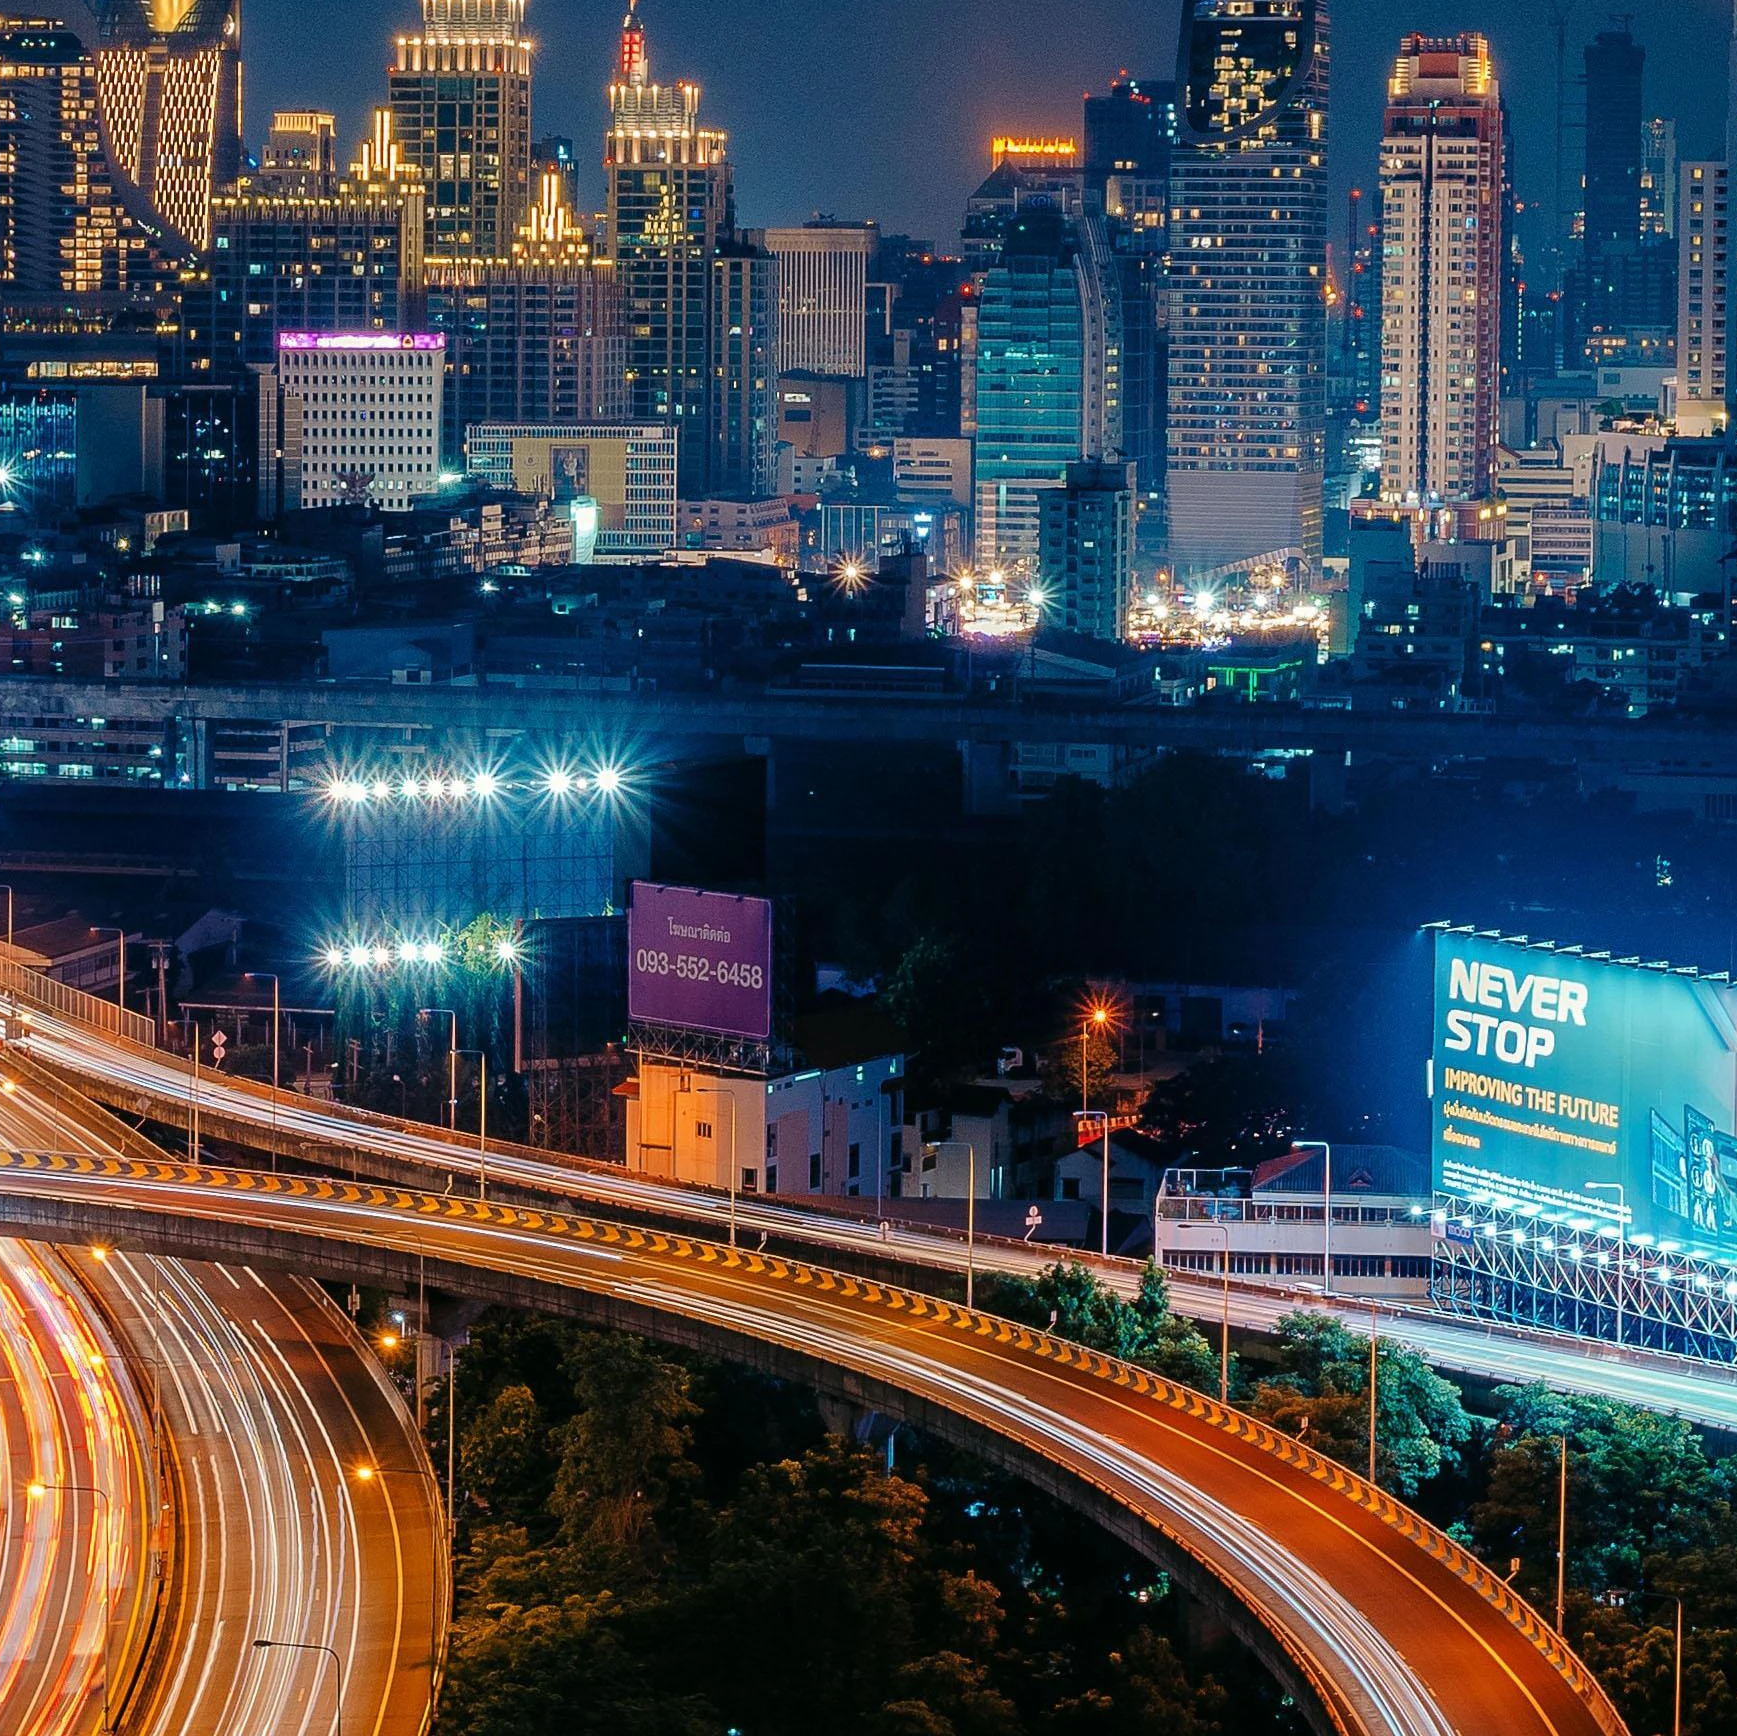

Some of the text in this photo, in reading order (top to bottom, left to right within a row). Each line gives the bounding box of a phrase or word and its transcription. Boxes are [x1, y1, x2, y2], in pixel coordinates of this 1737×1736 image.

[667, 916, 731, 944] โฆษณาติดต่อ
[636, 948, 764, 990] 093-552-6458
[1448, 957, 1589, 1027] NEVER
[1444, 1009, 1556, 1069] STOP
[1444, 1067, 1620, 1128] IMPROVING THE FUTURE
